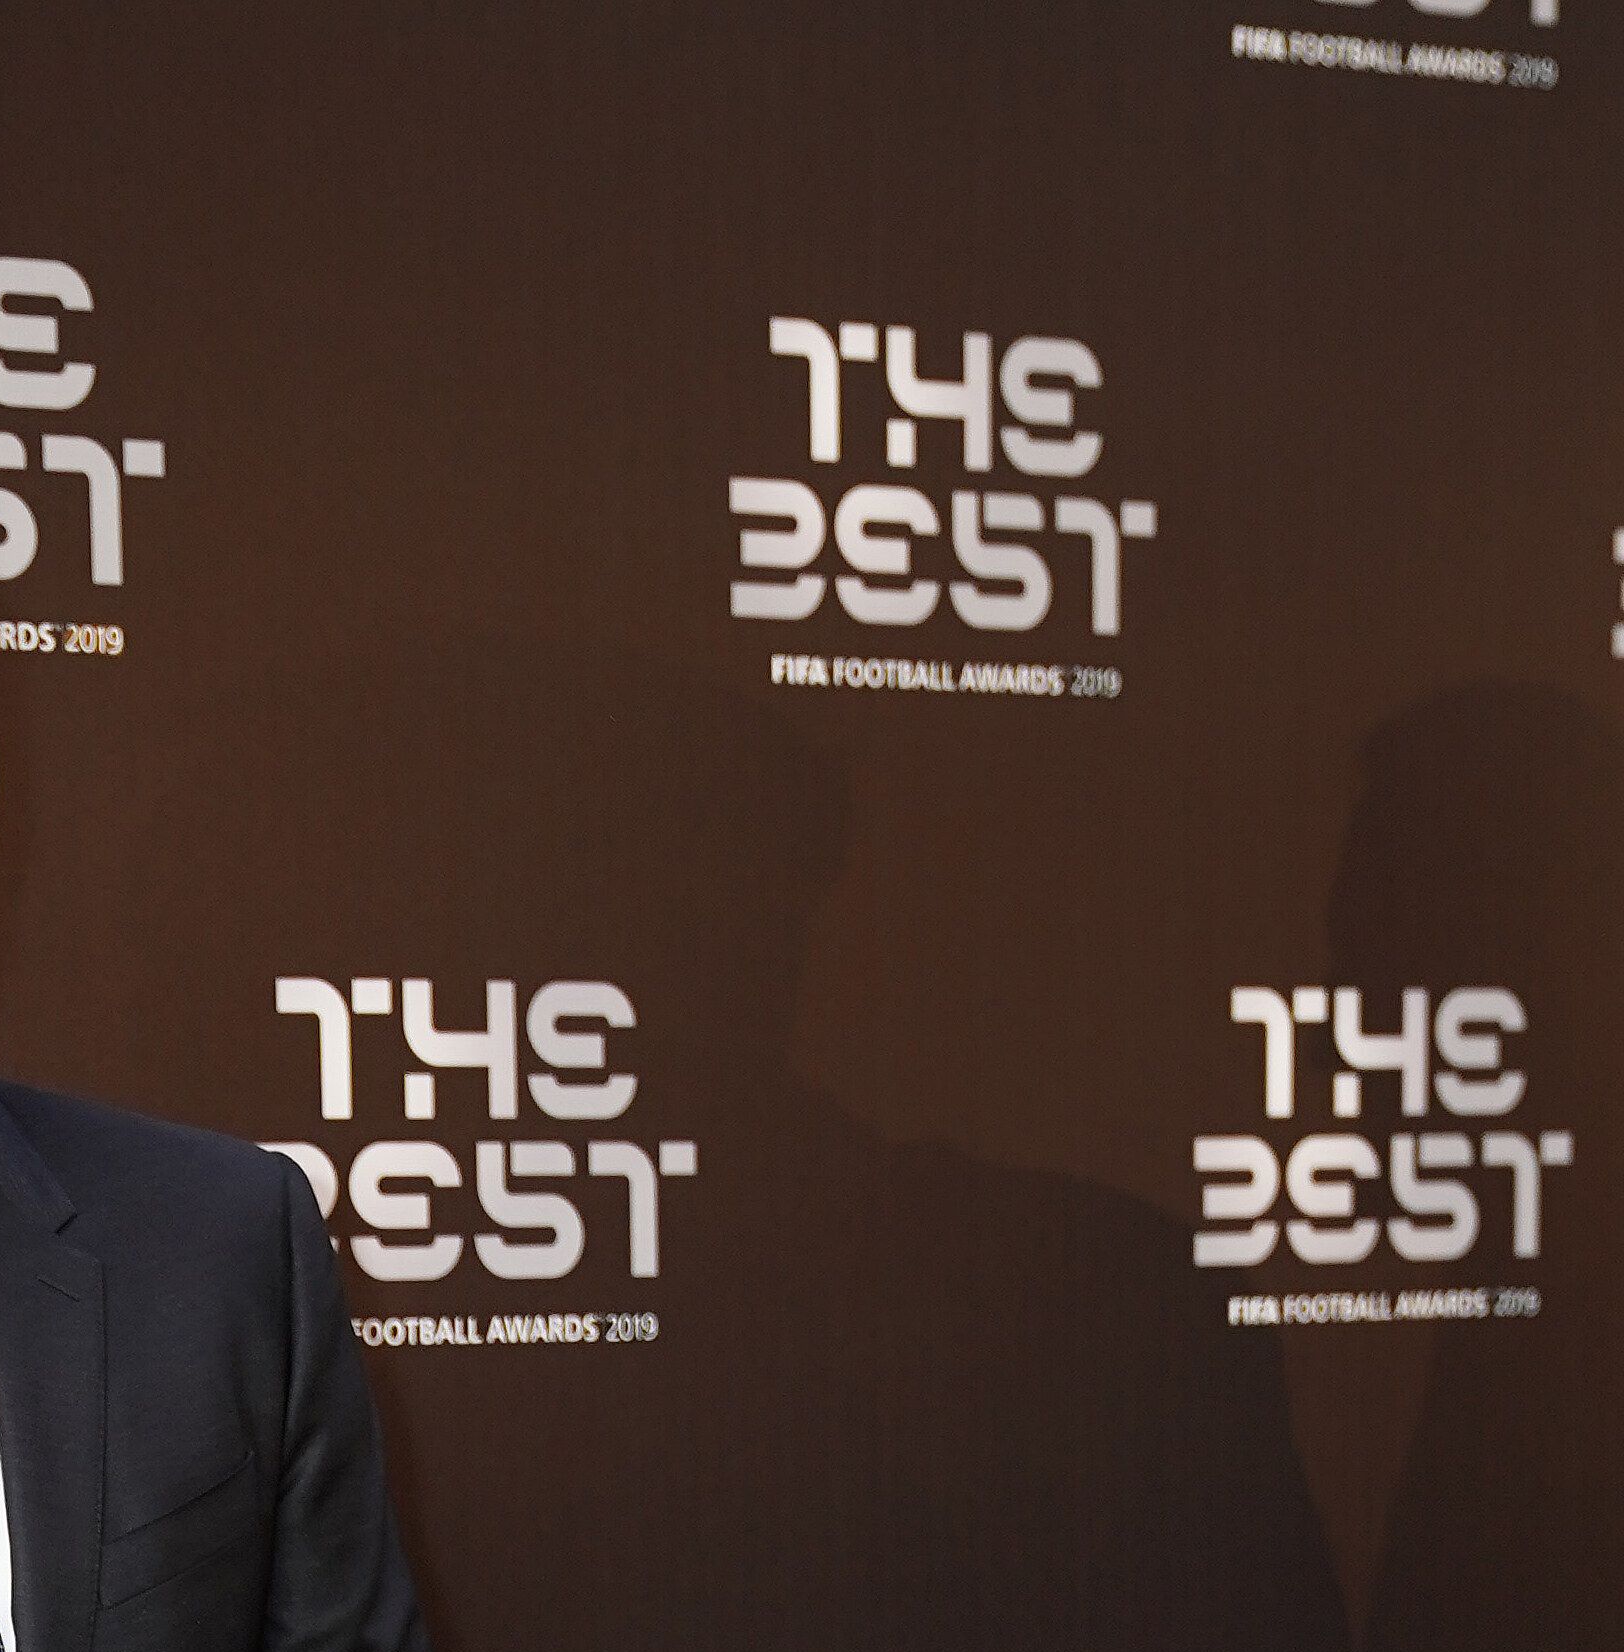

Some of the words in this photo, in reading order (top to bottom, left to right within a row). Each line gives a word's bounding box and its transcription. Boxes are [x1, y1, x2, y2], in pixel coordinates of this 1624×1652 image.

[769, 316, 1102, 477] THE
[729, 474, 1157, 635] BEST
[65, 623, 124, 655] 2019
[771, 654, 829, 685] FIFA
[833, 657, 957, 692] FOOTBALL
[959, 662, 1064, 696] AWARDS
[1072, 666, 1122, 697] 2019
[275, 977, 636, 1119] THE
[1231, 986, 1525, 1119] THE
[1193, 1132, 1572, 1266] BEST
[486, 1313, 600, 1343] AWARDS
[605, 1312, 659, 1342] 2019
